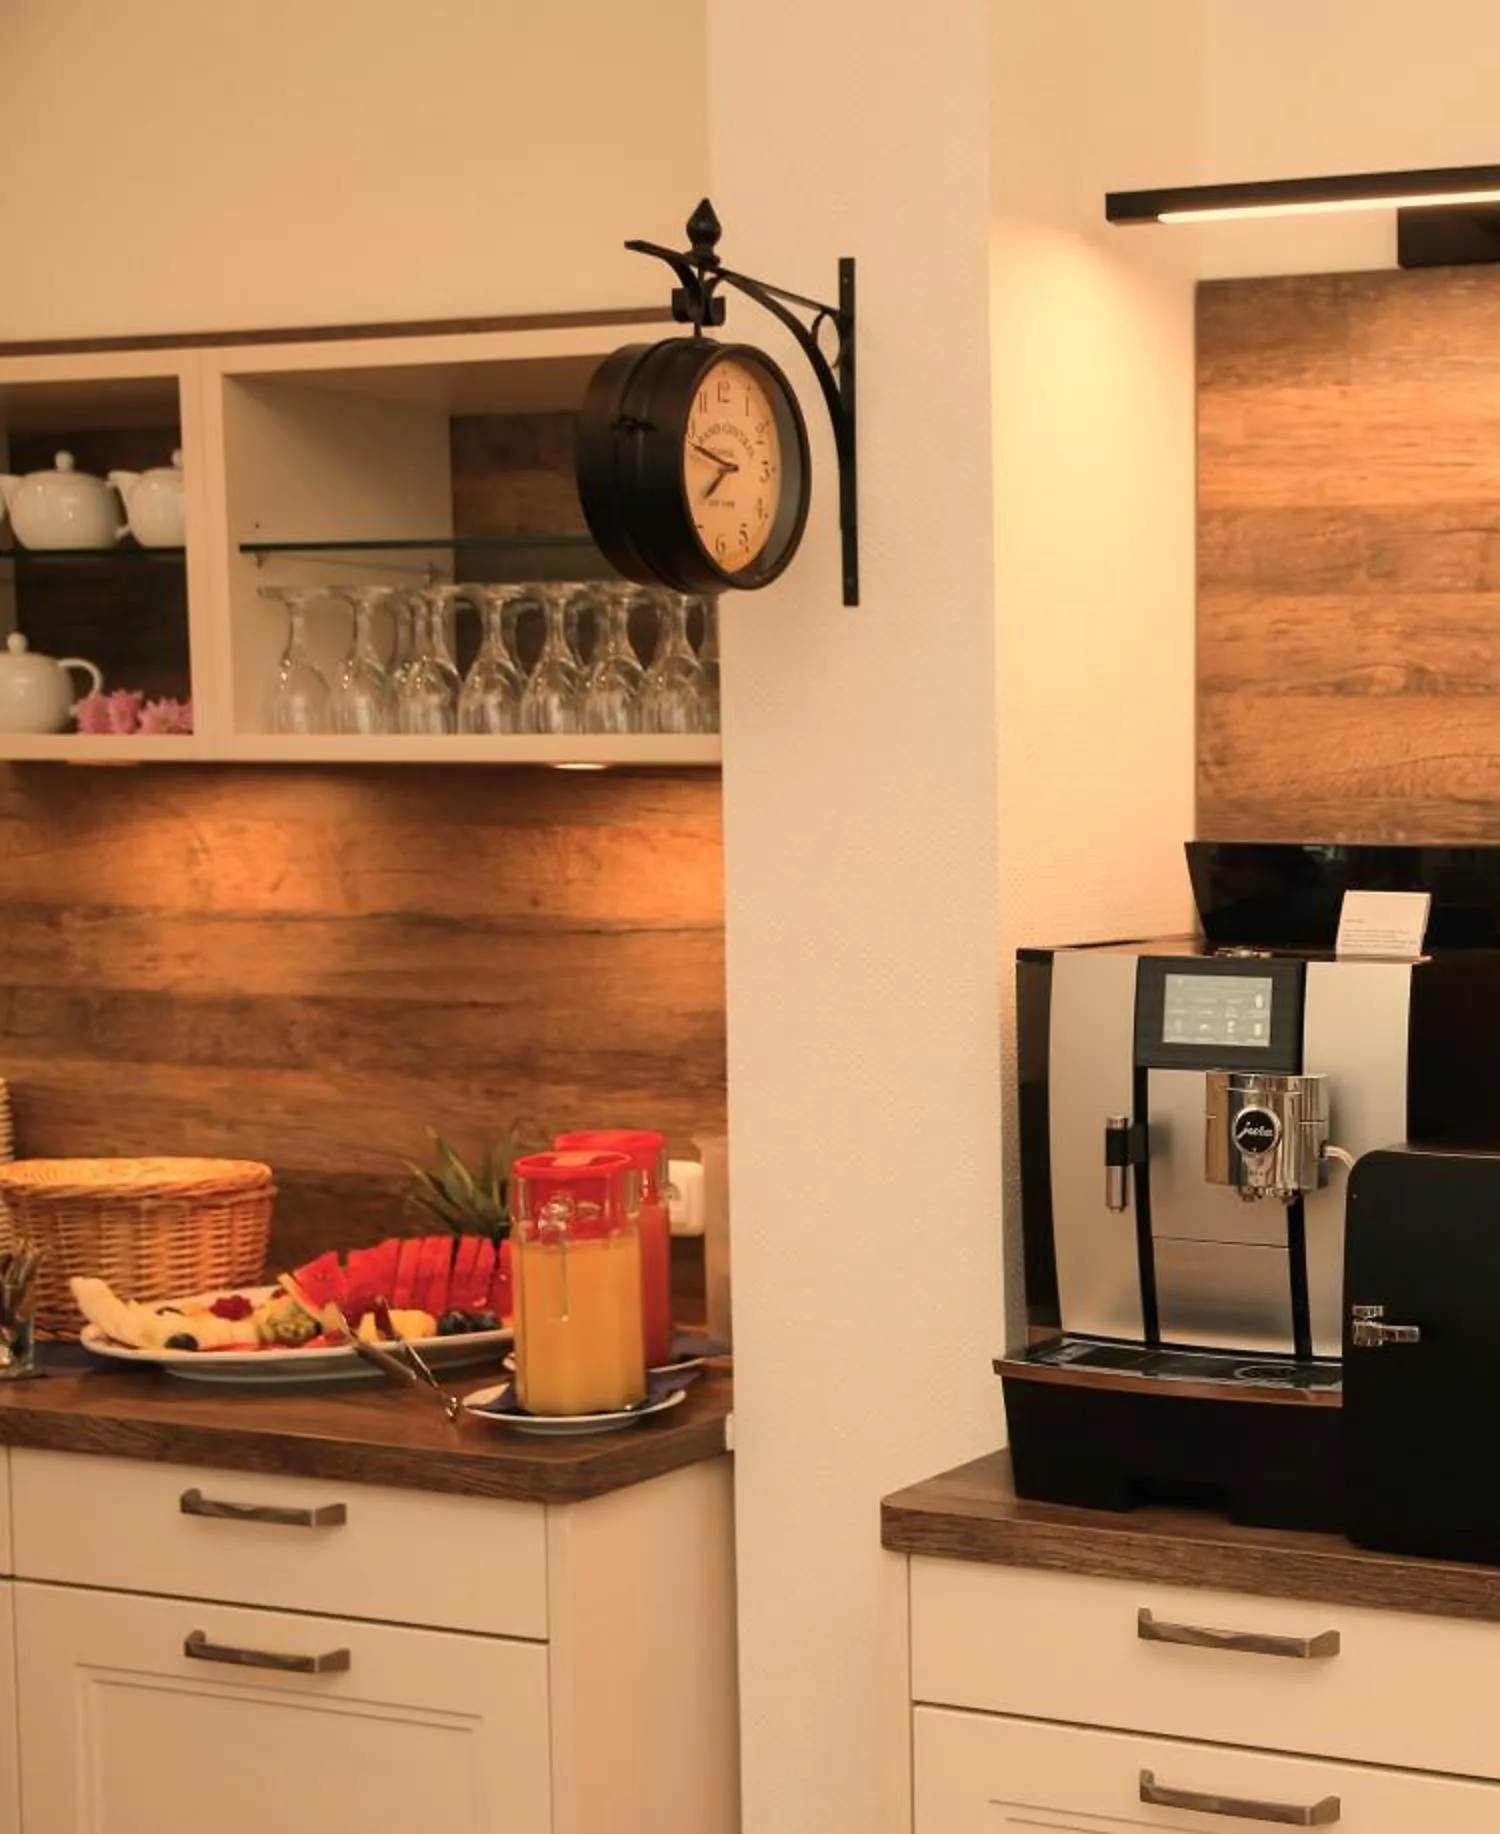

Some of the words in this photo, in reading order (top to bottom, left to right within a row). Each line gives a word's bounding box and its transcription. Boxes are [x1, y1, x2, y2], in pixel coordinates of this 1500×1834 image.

[717, 381, 730, 403] 12
[759, 460, 771, 484] 3
[715, 534, 726, 555] 6
[738, 522, 749, 546] 5
